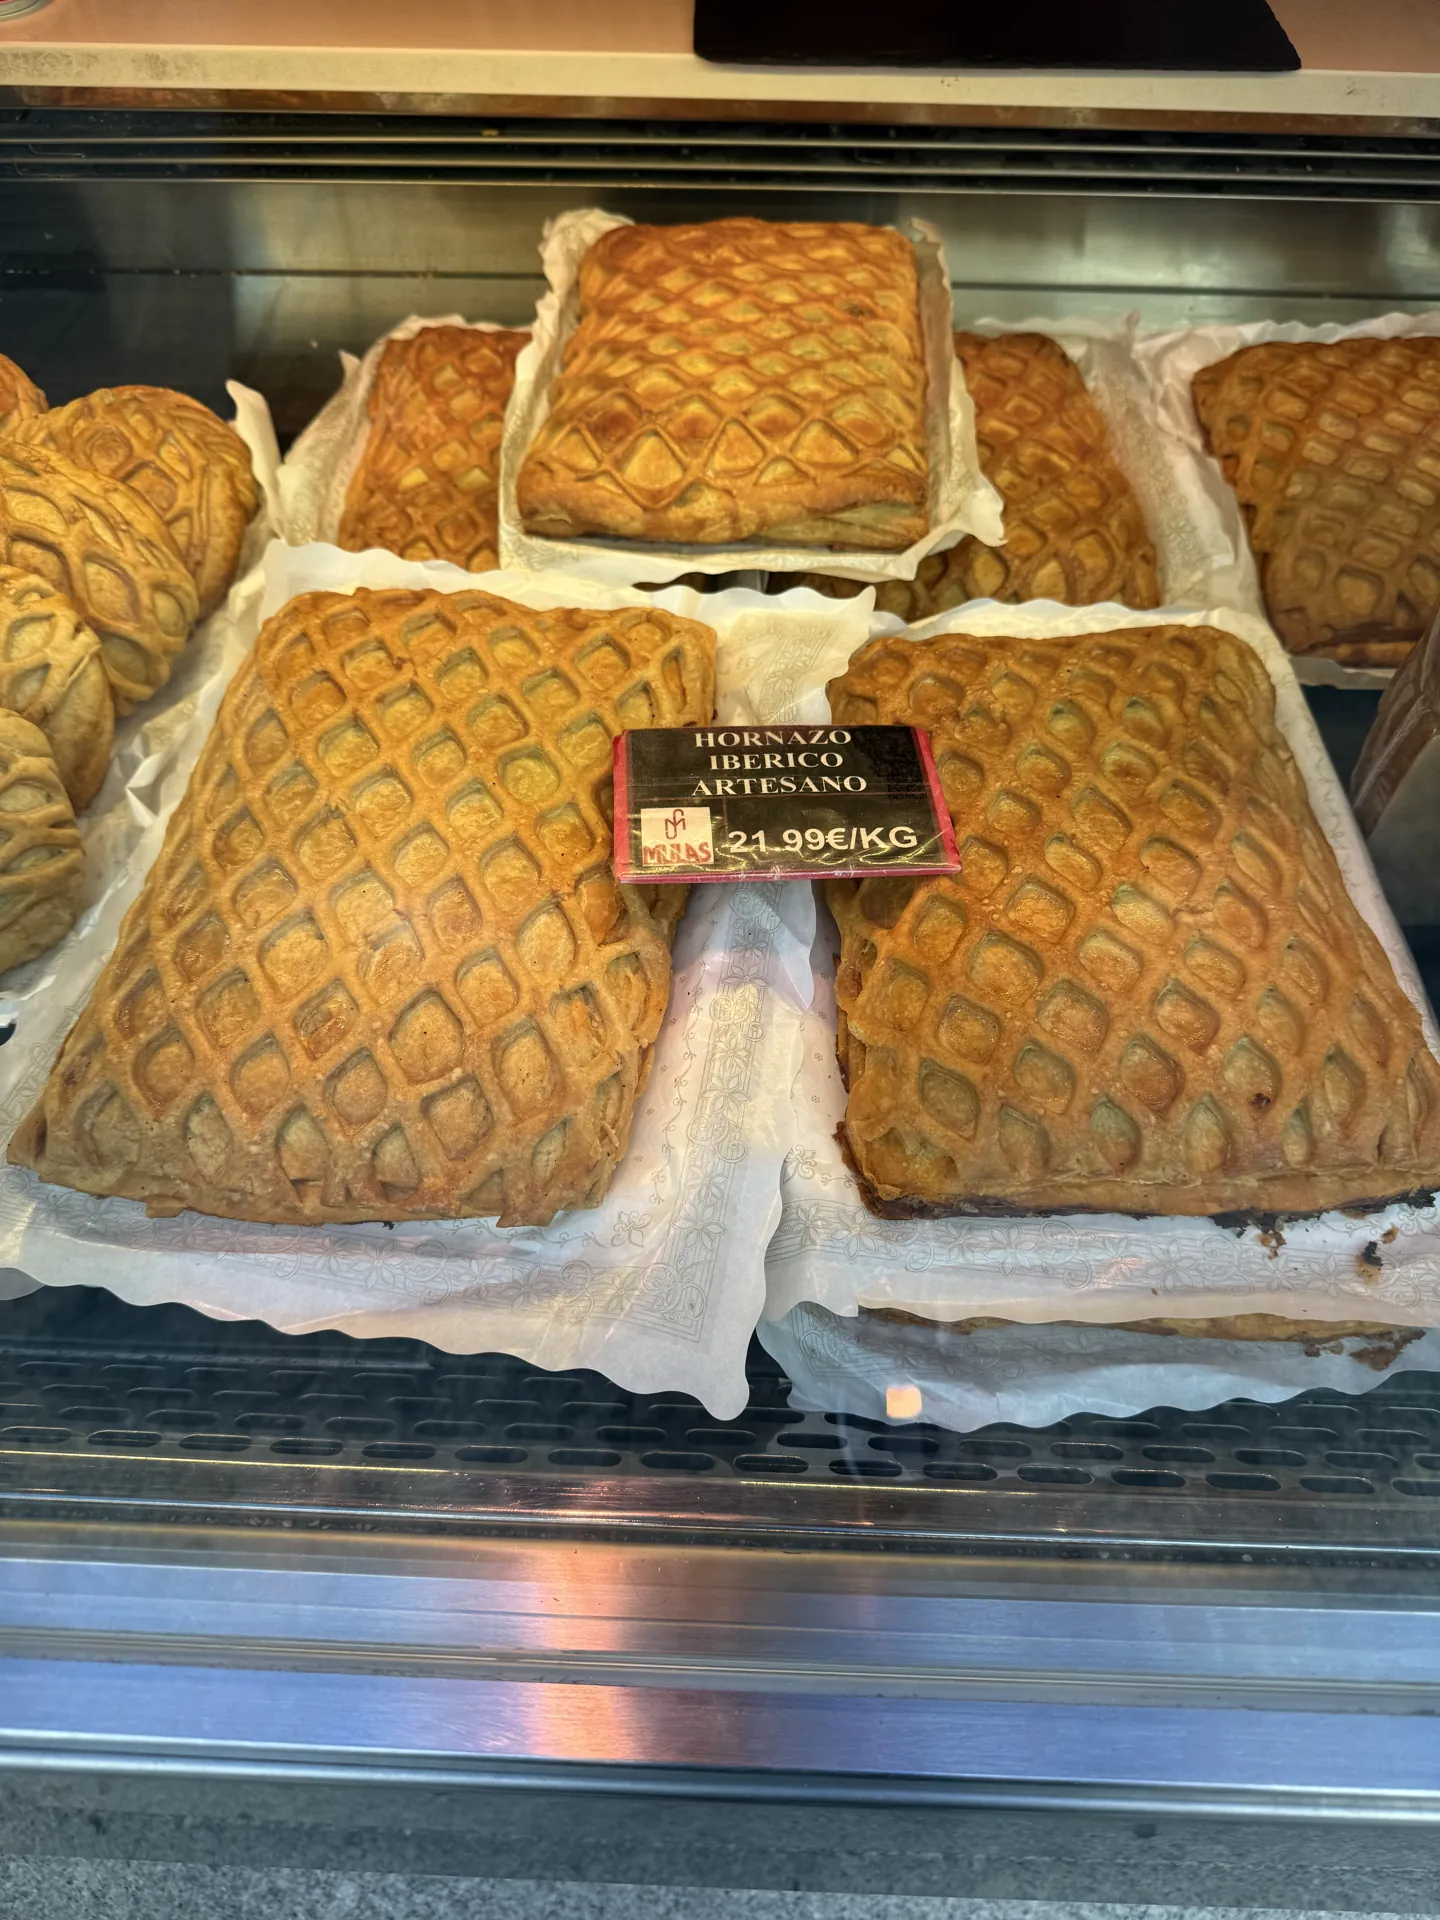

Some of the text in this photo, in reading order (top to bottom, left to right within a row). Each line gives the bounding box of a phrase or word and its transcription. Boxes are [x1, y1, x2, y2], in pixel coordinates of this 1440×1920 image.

[694, 730, 852, 748] HORNAZO
[709, 752, 843, 770] IBERICO
[691, 776, 867, 796] ARTESANO
